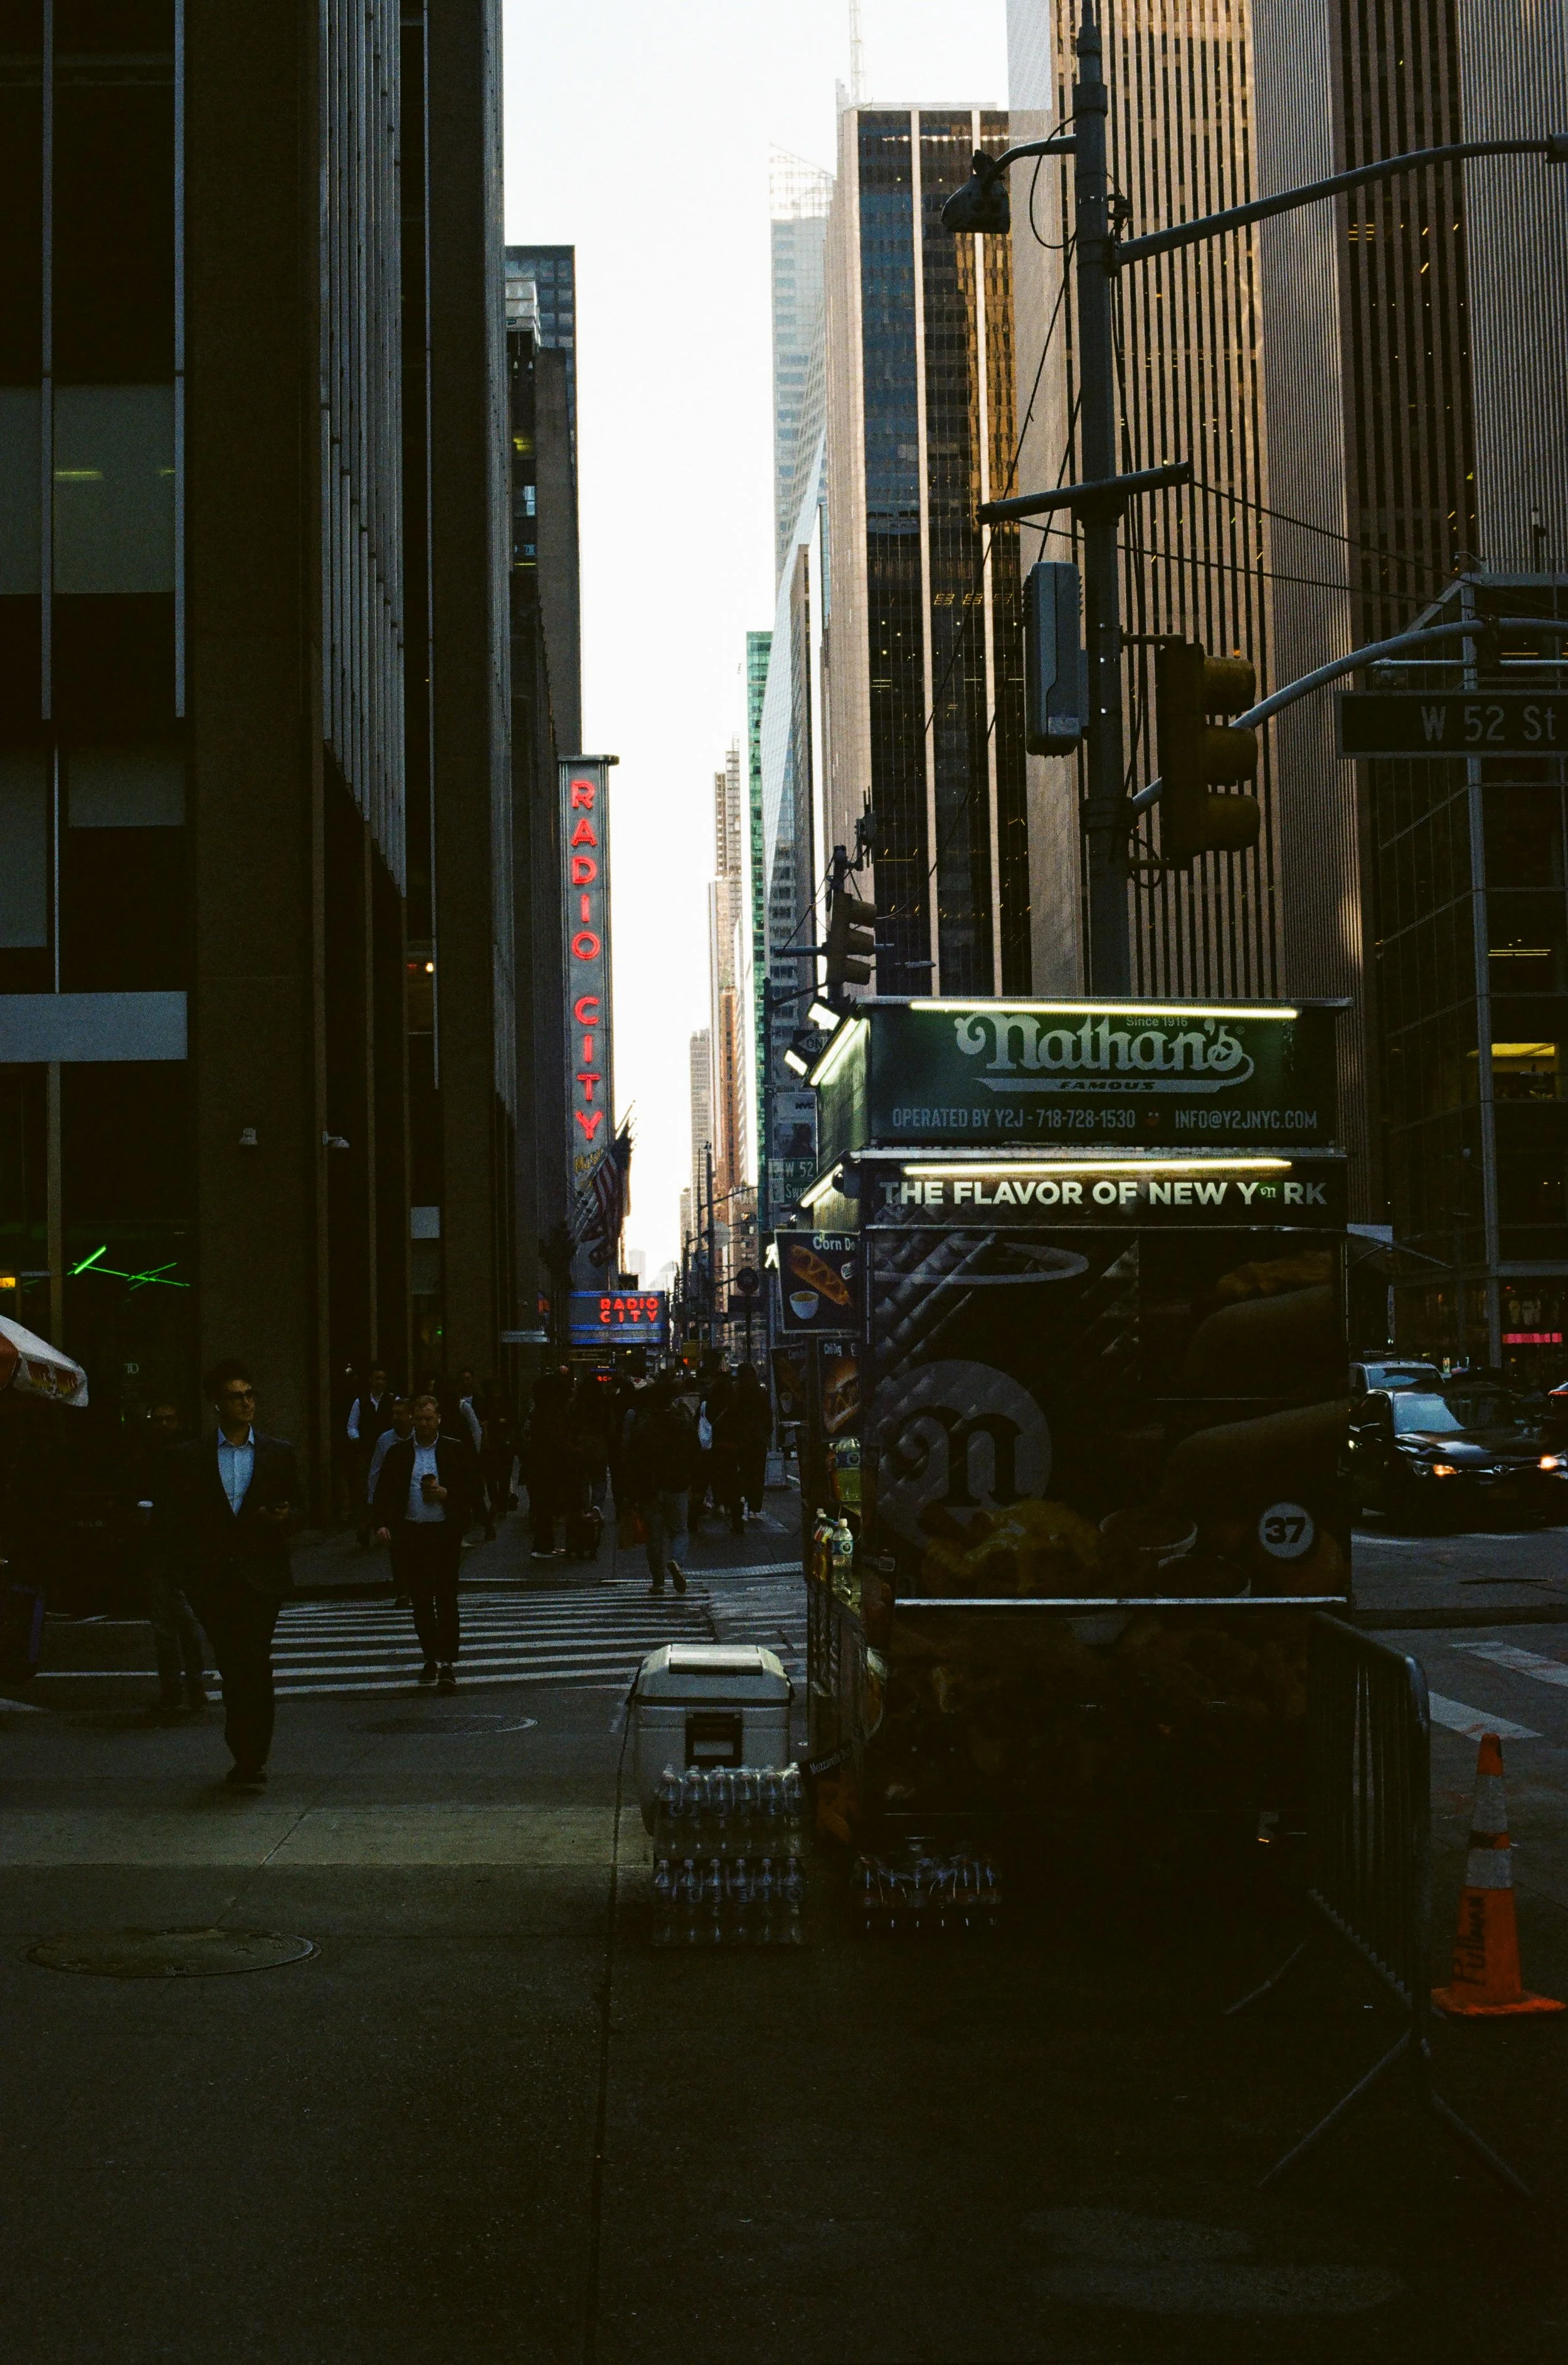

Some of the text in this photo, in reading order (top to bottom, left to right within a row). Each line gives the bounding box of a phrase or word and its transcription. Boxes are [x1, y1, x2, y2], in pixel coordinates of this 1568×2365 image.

[1420, 704, 1557, 741] W 52 St
[570, 780, 603, 1139] RADIO CITY
[1126, 1018, 1189, 1027] Since 1916
[954, 1012, 1243, 1071] Nathan's
[1059, 1081, 1157, 1090] FAMOUS
[892, 1108, 968, 1128] OPERATED
[972, 1108, 991, 1128] BY
[995, 1108, 1024, 1129] Y2J
[1036, 1109, 1136, 1129] 718-728-1530
[1174, 1110, 1318, 1129] INFO@Y2JNYC.COM
[879, 1182, 944, 1204] THE
[954, 1181, 1083, 1204] FLAVOR
[1092, 1181, 1138, 1204] OF
[1149, 1182, 1228, 1205] NEW
[813, 1236, 856, 1252] Corn Do
[599, 1297, 659, 1310] RADIO
[599, 1310, 659, 1324] CITY
[1264, 1516, 1306, 1544] 37
